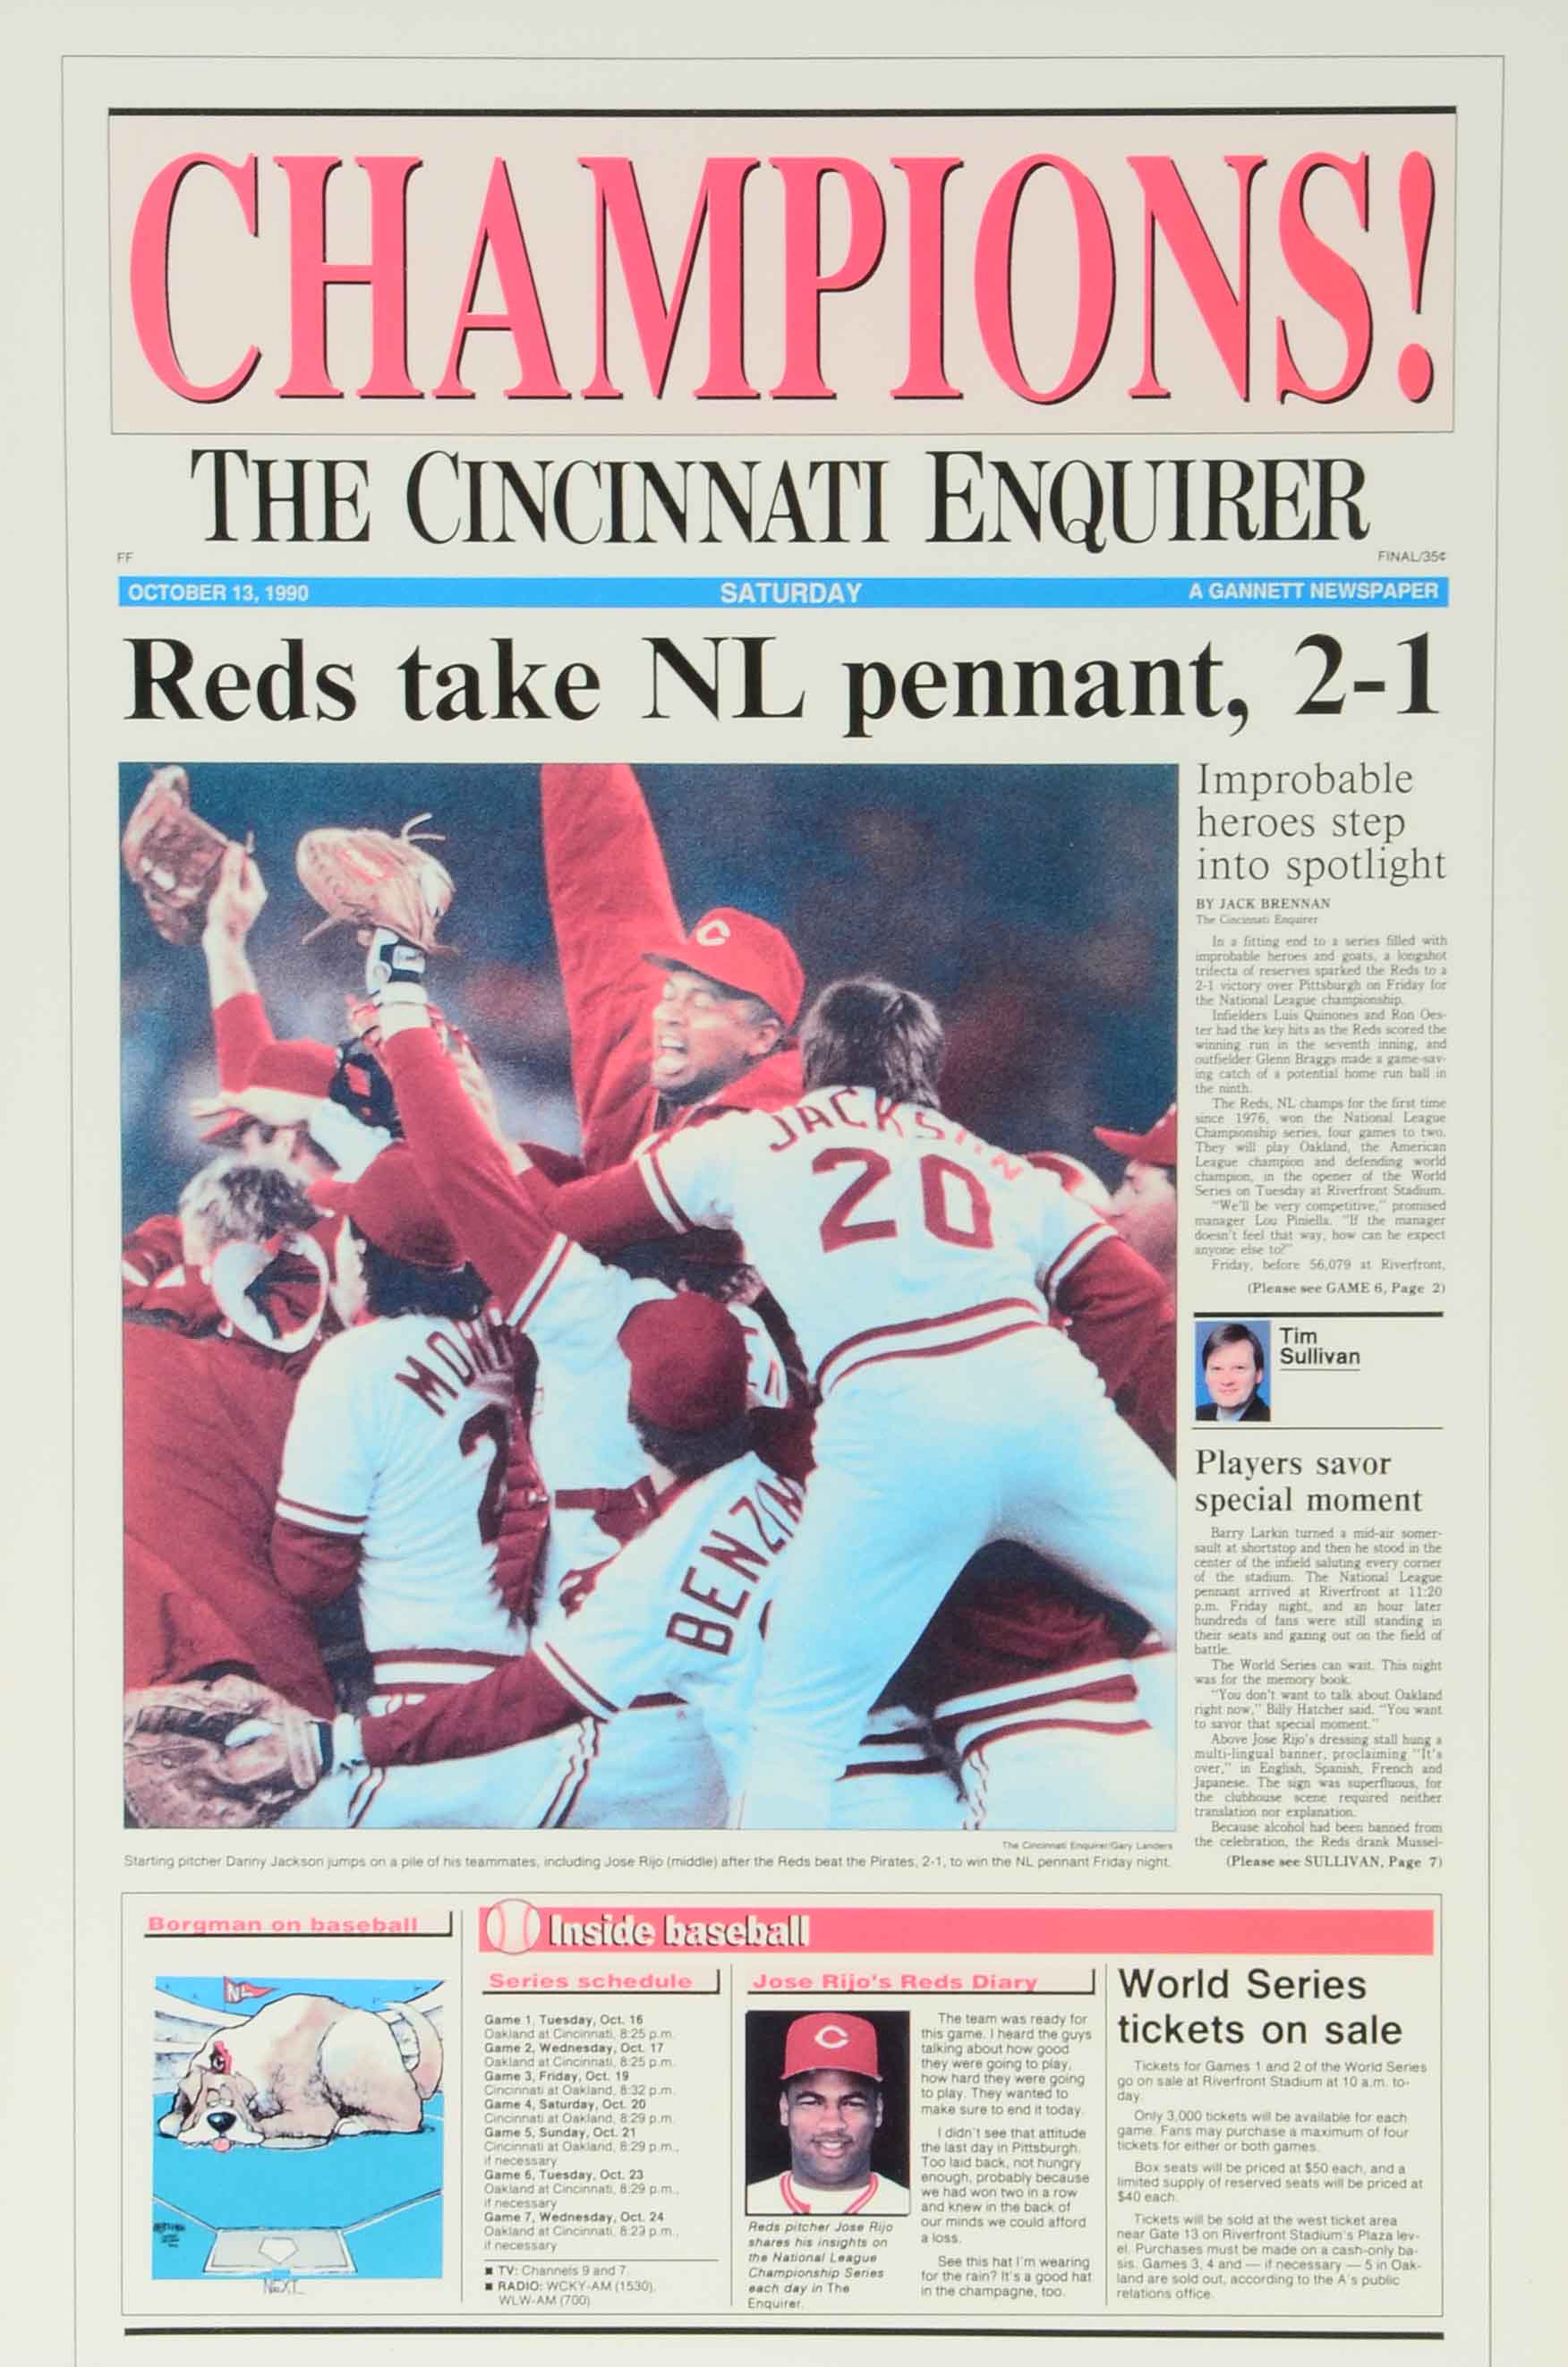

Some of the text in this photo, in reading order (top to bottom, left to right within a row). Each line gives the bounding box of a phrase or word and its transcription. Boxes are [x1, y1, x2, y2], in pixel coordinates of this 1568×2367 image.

[127, 151, 1438, 407] CHAMPIONS!
[191, 448, 1371, 555] THE CINCINNATI ENQUIRER
[116, 551, 134, 563] FF
[128, 583, 309, 602] OCTOBER 13, 1990
[720, 582, 862, 603] SATURDAY
[1189, 582, 1438, 600] A GANNETT NEWSPAPER
[123, 632, 1440, 738] Reds take NL pennant, 2-1
[1198, 762, 1413, 802] Improbable
[1197, 805, 1405, 844] heroes step
[1197, 846, 1447, 888] into spotlight
[1196, 898, 1331, 910] BY JACK BRENNAN
[812, 1146, 993, 1253] 20
[1248, 1281, 1446, 1297] (Please see GAME 6, Page 2)
[1278, 1326, 1317, 1345] Tim
[1280, 1347, 1360, 1365] Sullivan
[1197, 1449, 1392, 1481] Players savor
[1195, 1486, 1422, 1518] special moment
[1211, 1526, 1443, 1541] Barry Larkin turned a mid-air somer-
[124, 1854, 1170, 1871] Starting pitcher Danny Jackson jumps on a pile of his teammates, including Jose Rijo (middle) after the Reds beat the Pirates, 2-1, to win the NL pennant Friday night.
[1226, 1854, 1443, 1870] (Please see SULLIVAN, Page 7)
[148, 1916, 417, 1933] Borgman on baseball
[551, 1913, 810, 1946] Inside baseball
[490, 1972, 692, 1989] Series schedule
[753, 1973, 1037, 1991] Jose Rijo's Reds Diary
[1118, 1968, 1367, 2000] World Series
[484, 2014, 643, 2030] Game 1, Tuesday, Oct. 16
[937, 2012, 1087, 2027] The team was ready for
[814, 2024, 848, 2048] C
[1117, 2013, 1402, 2046] tickets on sale
[484, 2042, 664, 2056] Game 2, Wednesday, Oct. 17
[1134, 2059, 1180, 2072] Tickets
[1184, 2061, 1201, 2072] for
[1205, 2059, 1251, 2073] Games
[1265, 2061, 1290, 2073] and
[1292, 2060, 1301, 2073] 2
[1304, 2061, 1317, 2073] of
[1320, 2061, 1342, 2073] the
[1344, 2061, 1383, 2073] World
[1385, 2060, 1427, 2073] Series
[748, 2220, 893, 2235] Reds pitcher Jose Rijo
